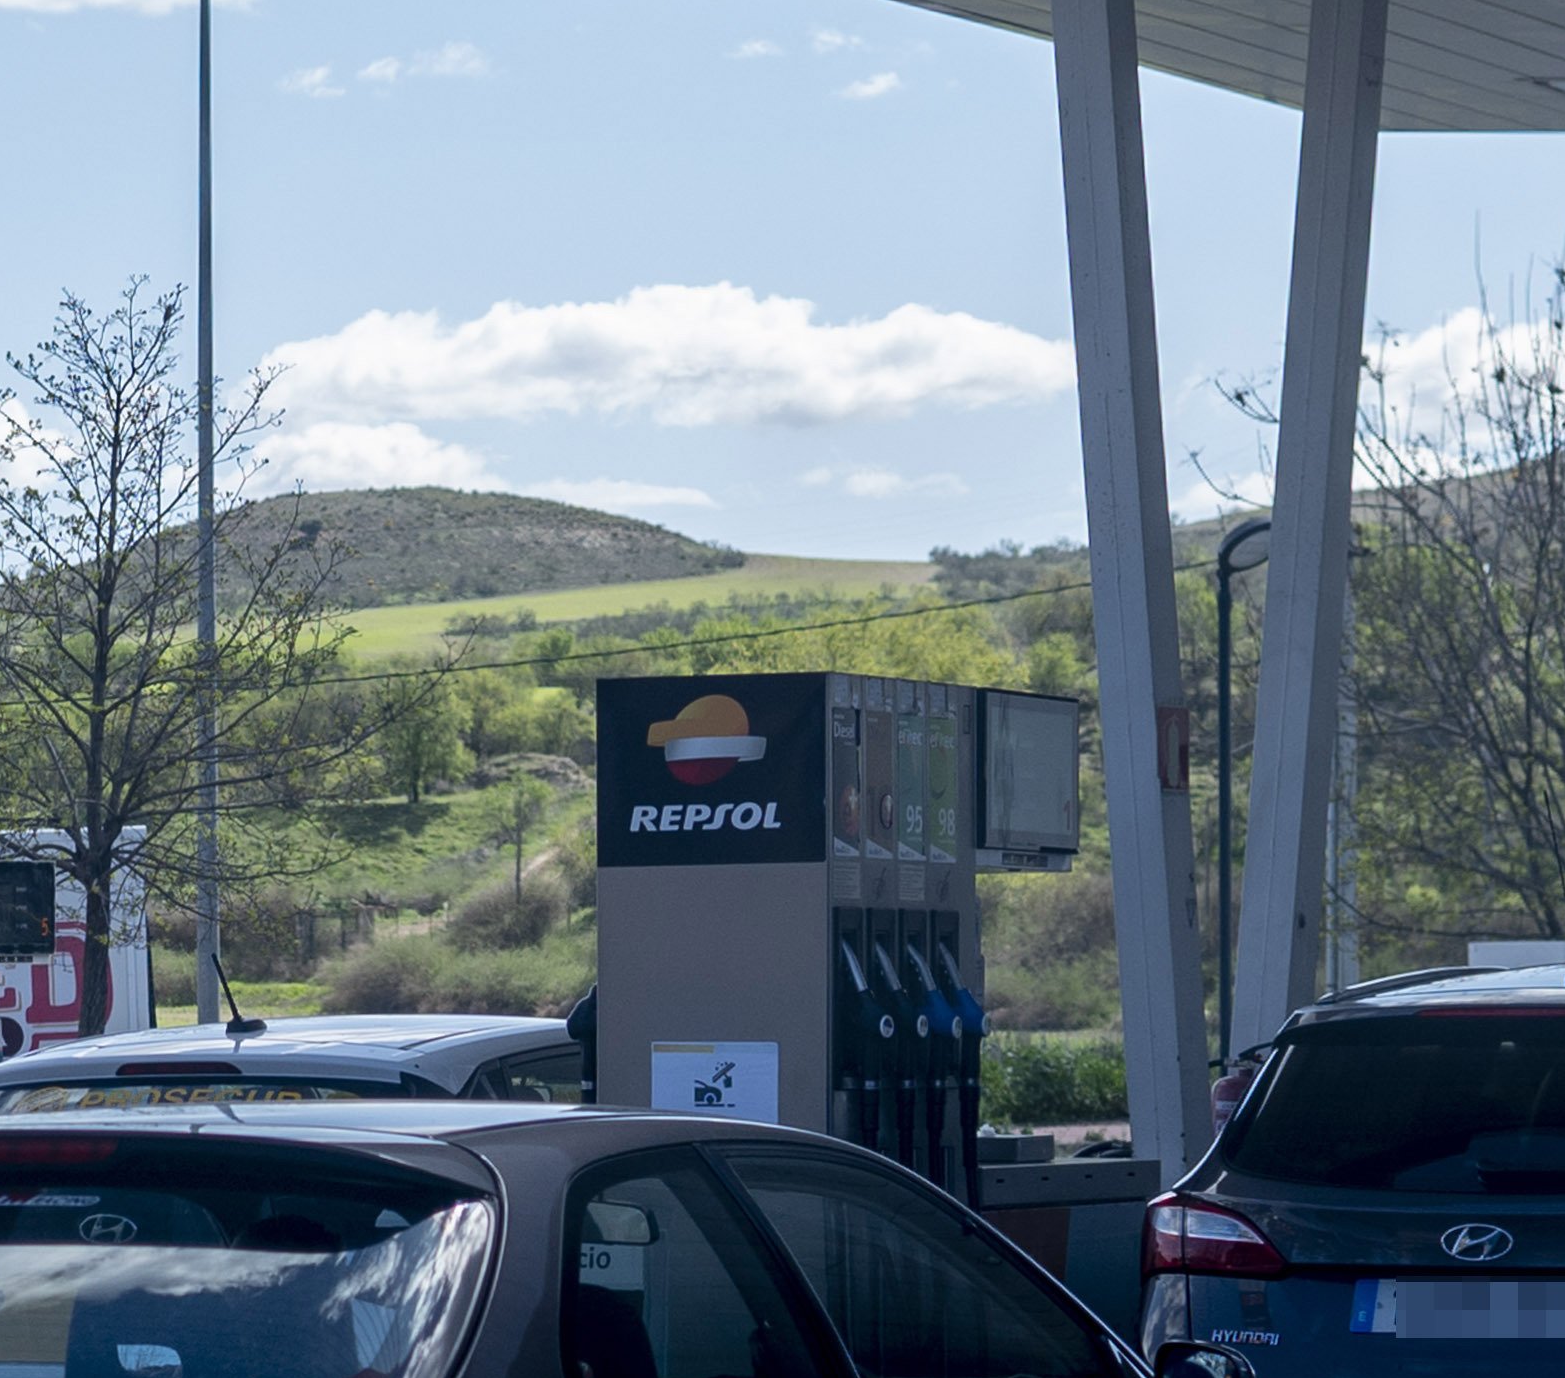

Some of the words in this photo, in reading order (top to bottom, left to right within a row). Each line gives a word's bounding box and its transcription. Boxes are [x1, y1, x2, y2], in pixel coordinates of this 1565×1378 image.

[628, 800, 782, 834] REPSOL
[905, 804, 924, 835] 95
[937, 807, 956, 837] 98
[1210, 1328, 1280, 1346] HYUNDAI
